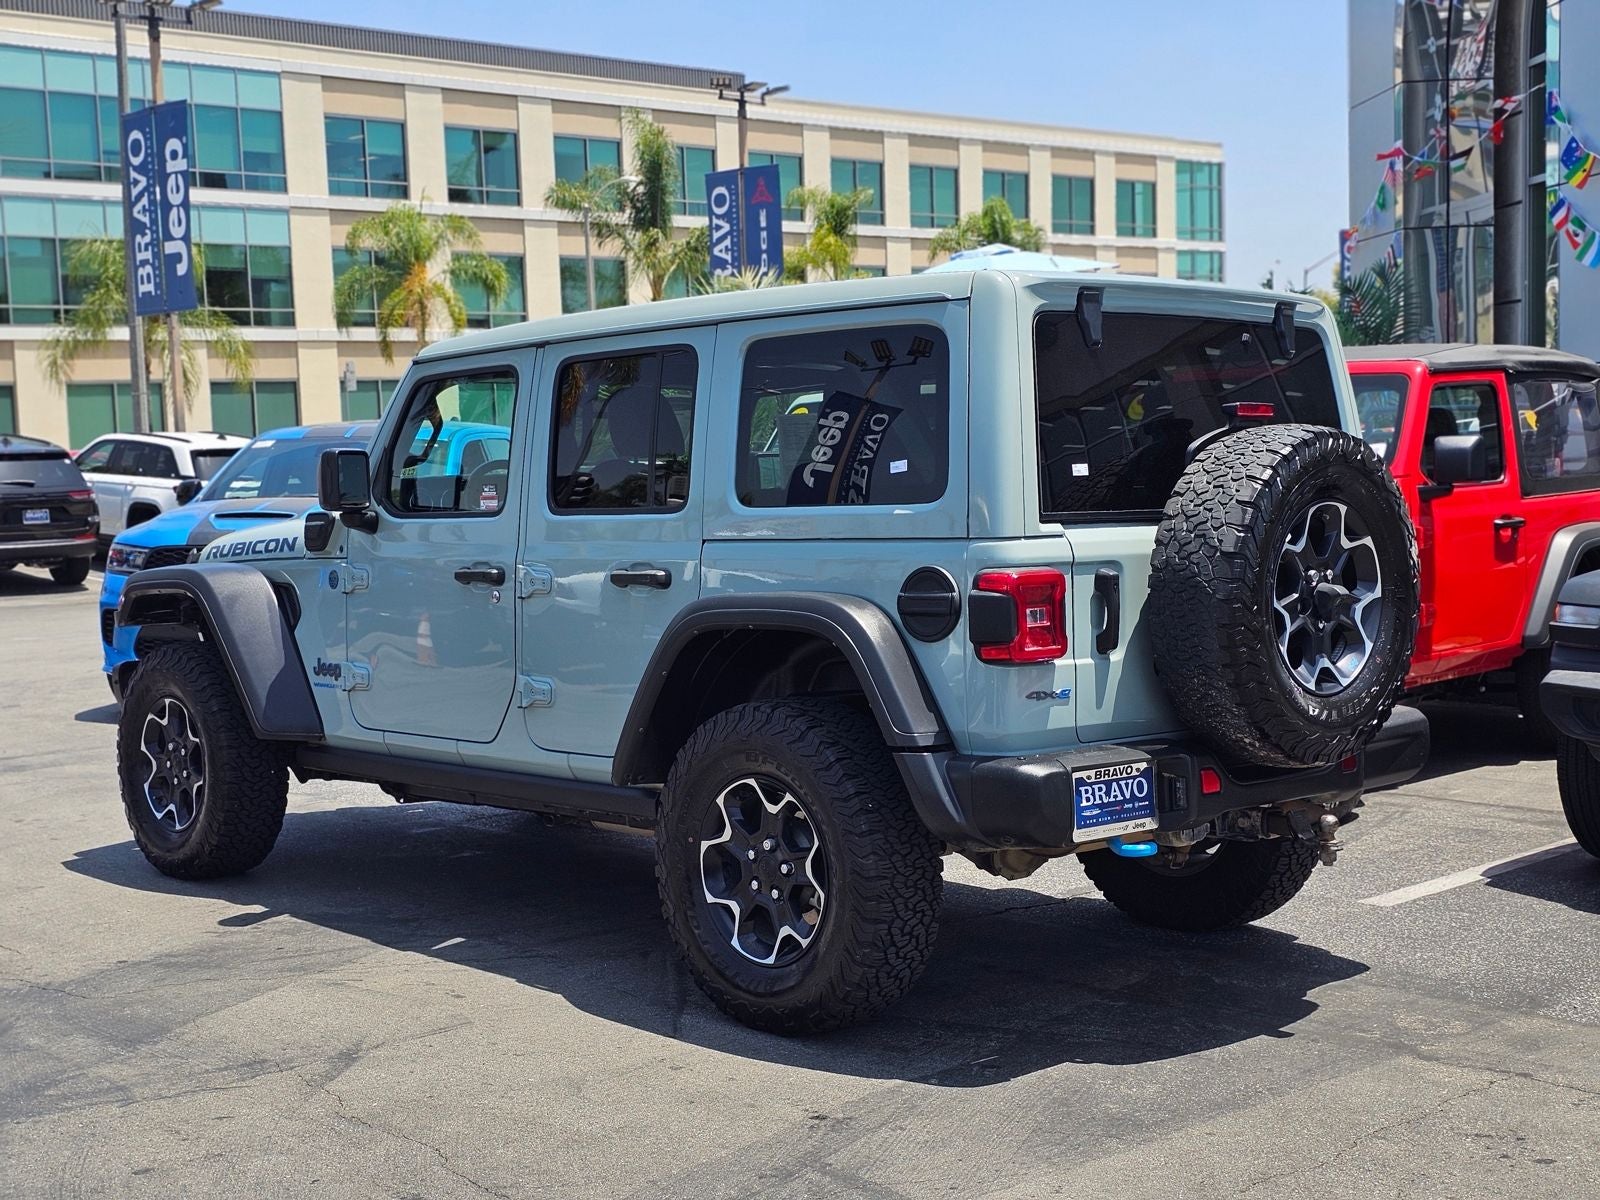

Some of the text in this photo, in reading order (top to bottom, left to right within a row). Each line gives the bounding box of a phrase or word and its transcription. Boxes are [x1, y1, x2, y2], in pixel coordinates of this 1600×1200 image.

[127, 129, 155, 298] BRAVO
[164, 137, 188, 277] Jeep
[711, 186, 733, 276] RAVO
[205, 536, 299, 560] RUBICON
[313, 657, 342, 681] Jeep
[1094, 765, 1133, 780] BRAVO
[1078, 777, 1148, 807] BRAVO
[1132, 822, 1147, 830] Jeep
